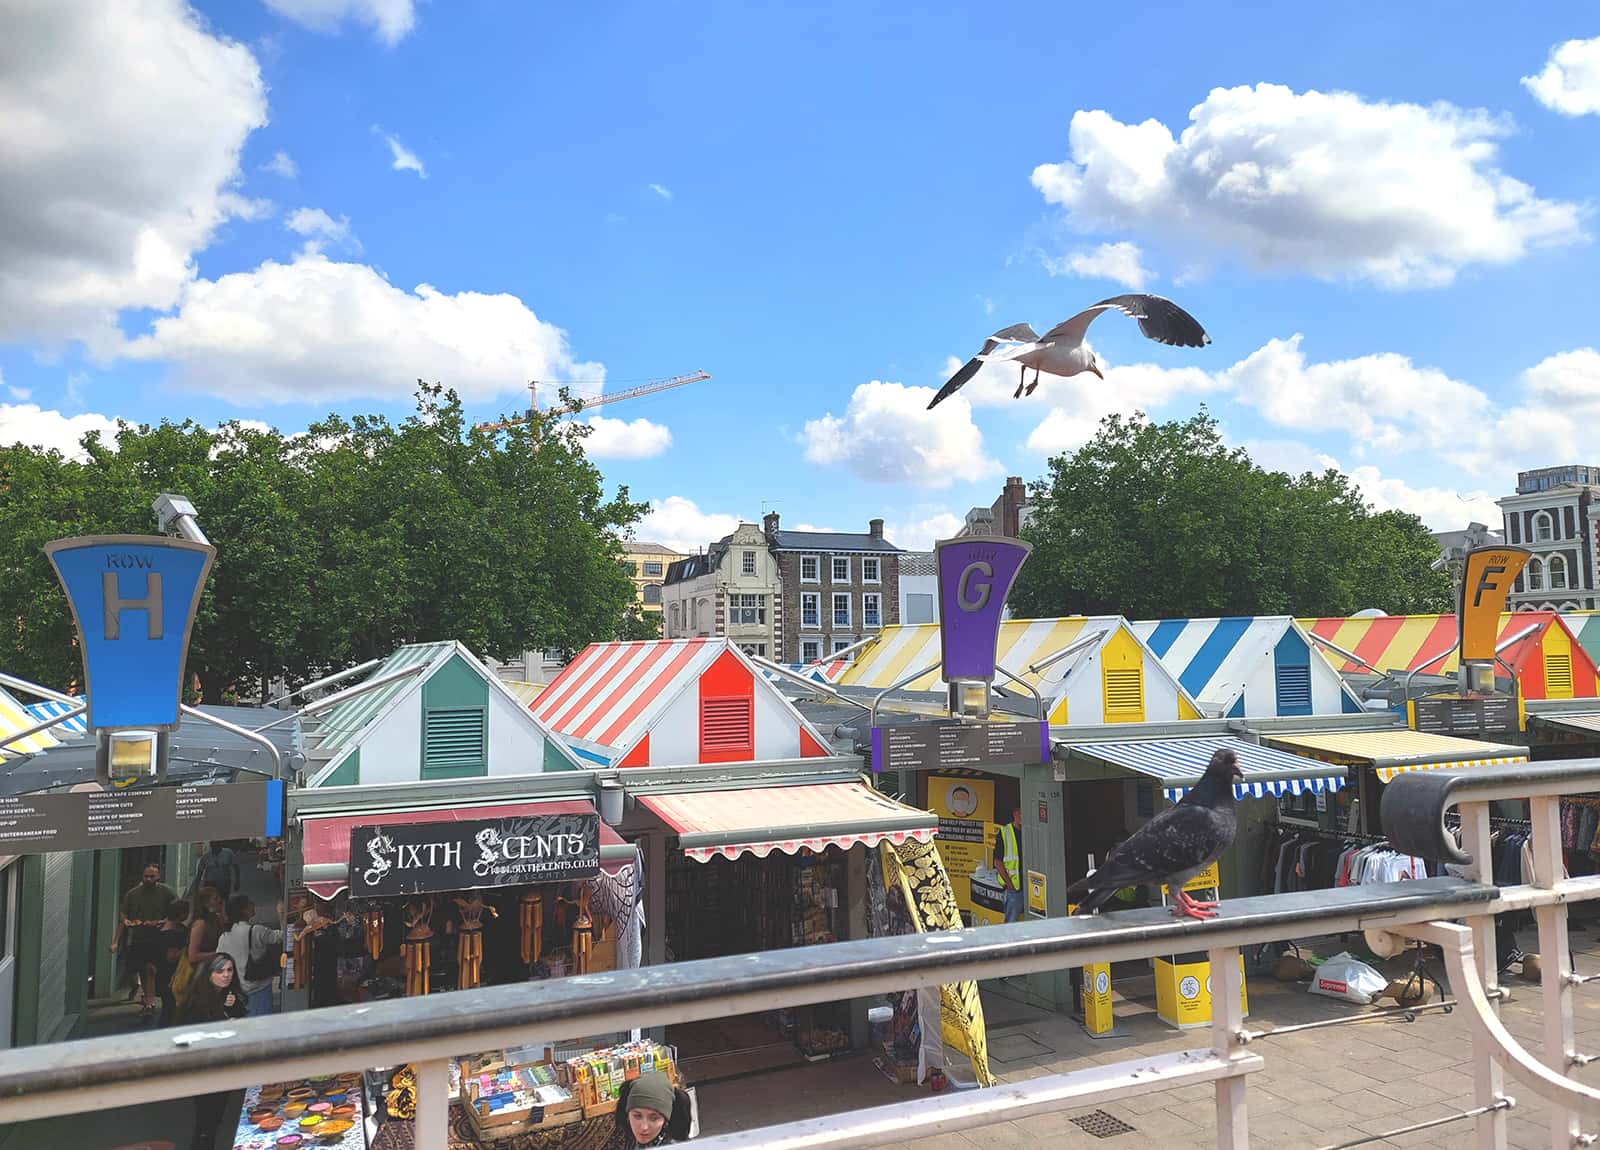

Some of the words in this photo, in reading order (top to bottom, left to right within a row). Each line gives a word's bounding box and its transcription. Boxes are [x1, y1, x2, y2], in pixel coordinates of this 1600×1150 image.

[105, 551, 153, 568] ROW
[1488, 555, 1511, 565] ROW
[103, 572, 163, 641] H
[958, 561, 994, 612] G
[1473, 566, 1506, 607] F
[364, 834, 462, 886] SIXTH
[473, 828, 584, 877] SCENTS
